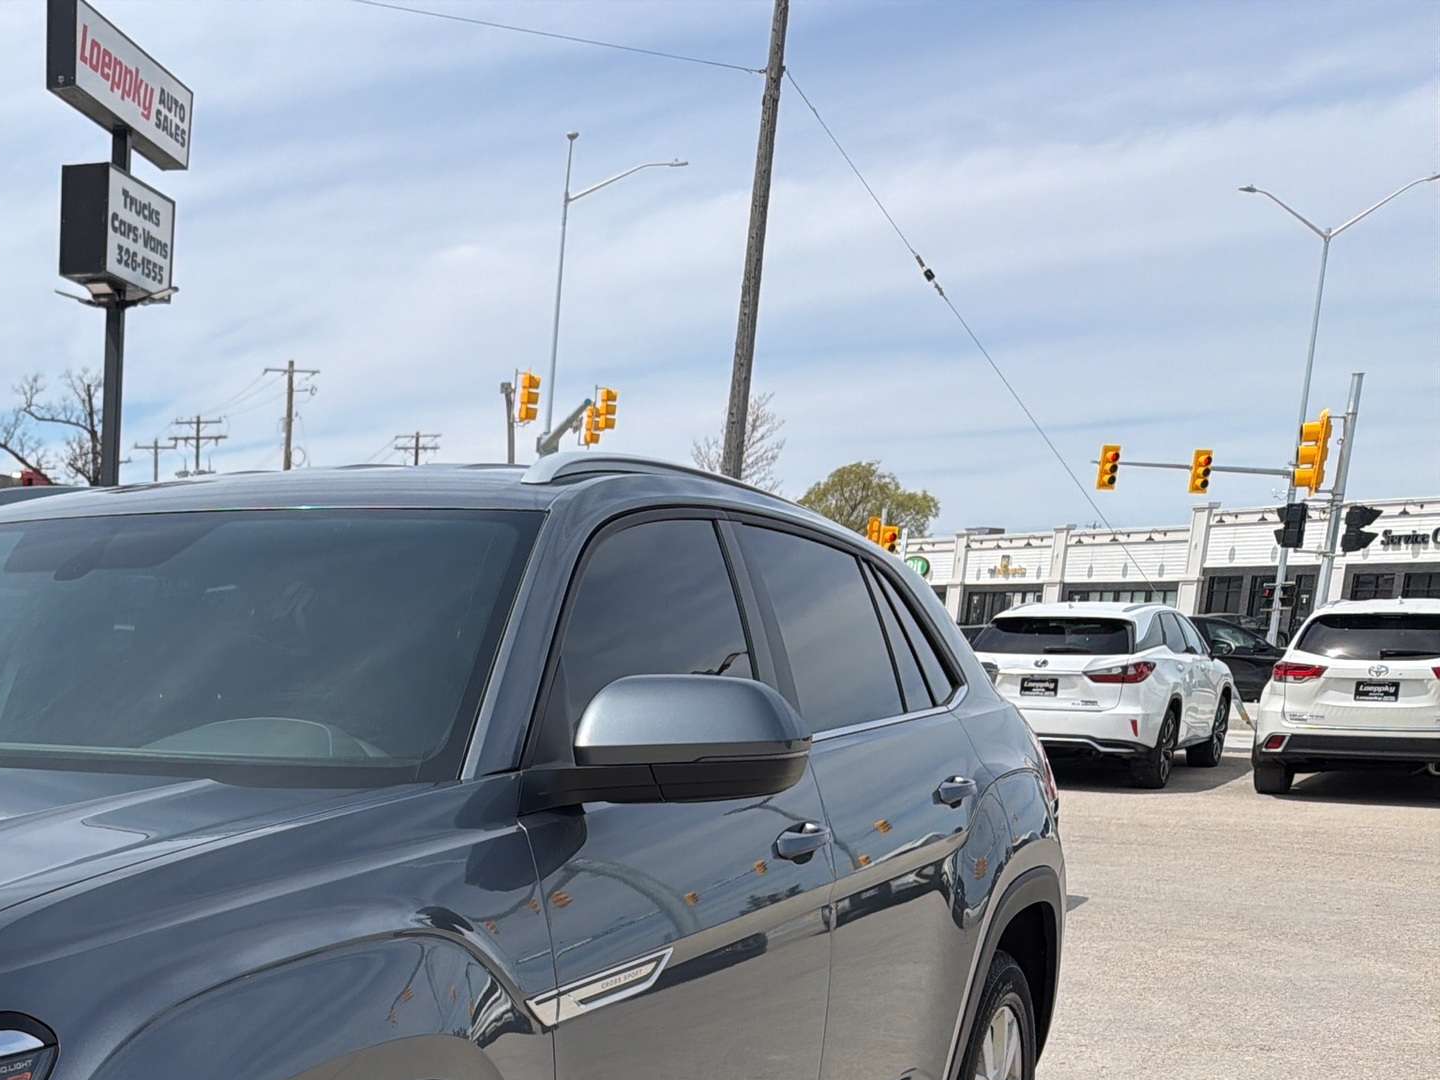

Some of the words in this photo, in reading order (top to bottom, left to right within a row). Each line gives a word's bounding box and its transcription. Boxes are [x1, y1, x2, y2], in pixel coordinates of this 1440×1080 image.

[79, 24, 155, 121] Loeppky
[158, 87, 186, 122] AUTO
[154, 108, 186, 148] SALES
[121, 187, 160, 228] Trucks
[116, 244, 164, 285] 326-1555
[1381, 529, 1430, 546] Service
